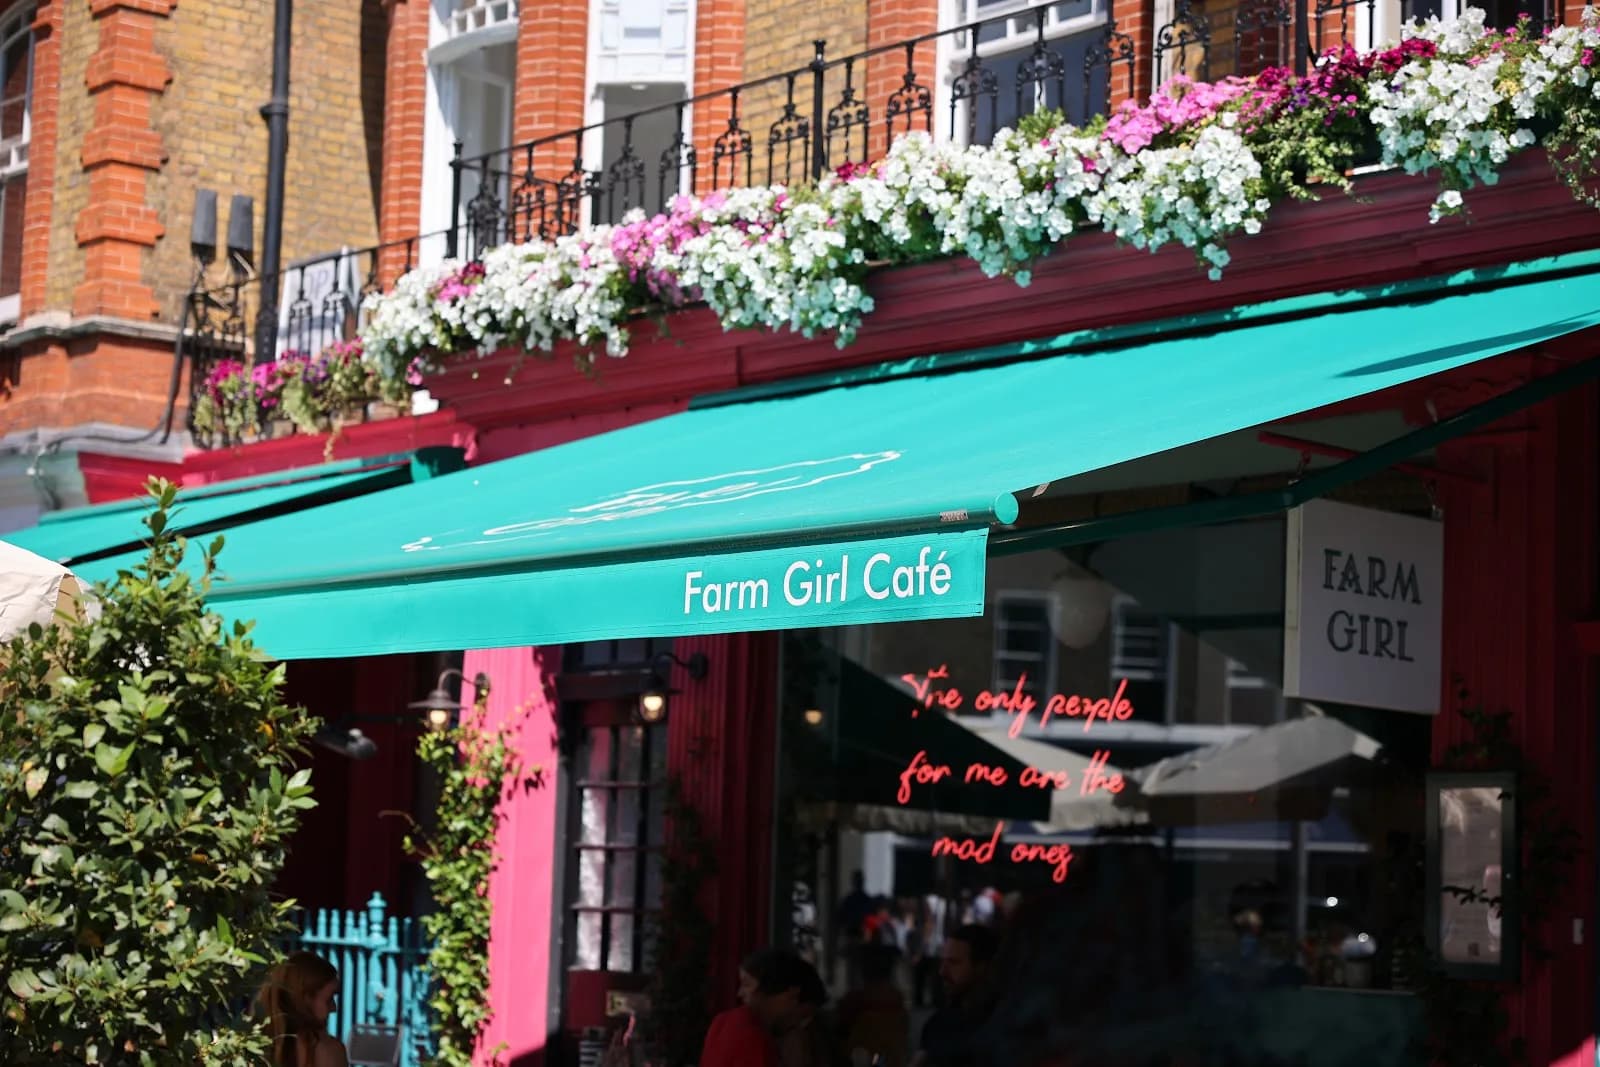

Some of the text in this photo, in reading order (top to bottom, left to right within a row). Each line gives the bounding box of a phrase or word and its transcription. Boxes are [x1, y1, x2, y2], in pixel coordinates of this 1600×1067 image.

[684, 546, 952, 614] Farm Girl Café
[1322, 548, 1422, 605] FARM
[1327, 610, 1415, 663] GIRL
[974, 673, 1036, 739] only
[1040, 678, 1134, 732] people
[897, 751, 1125, 804] for me are the
[932, 821, 1074, 883] mad ones
